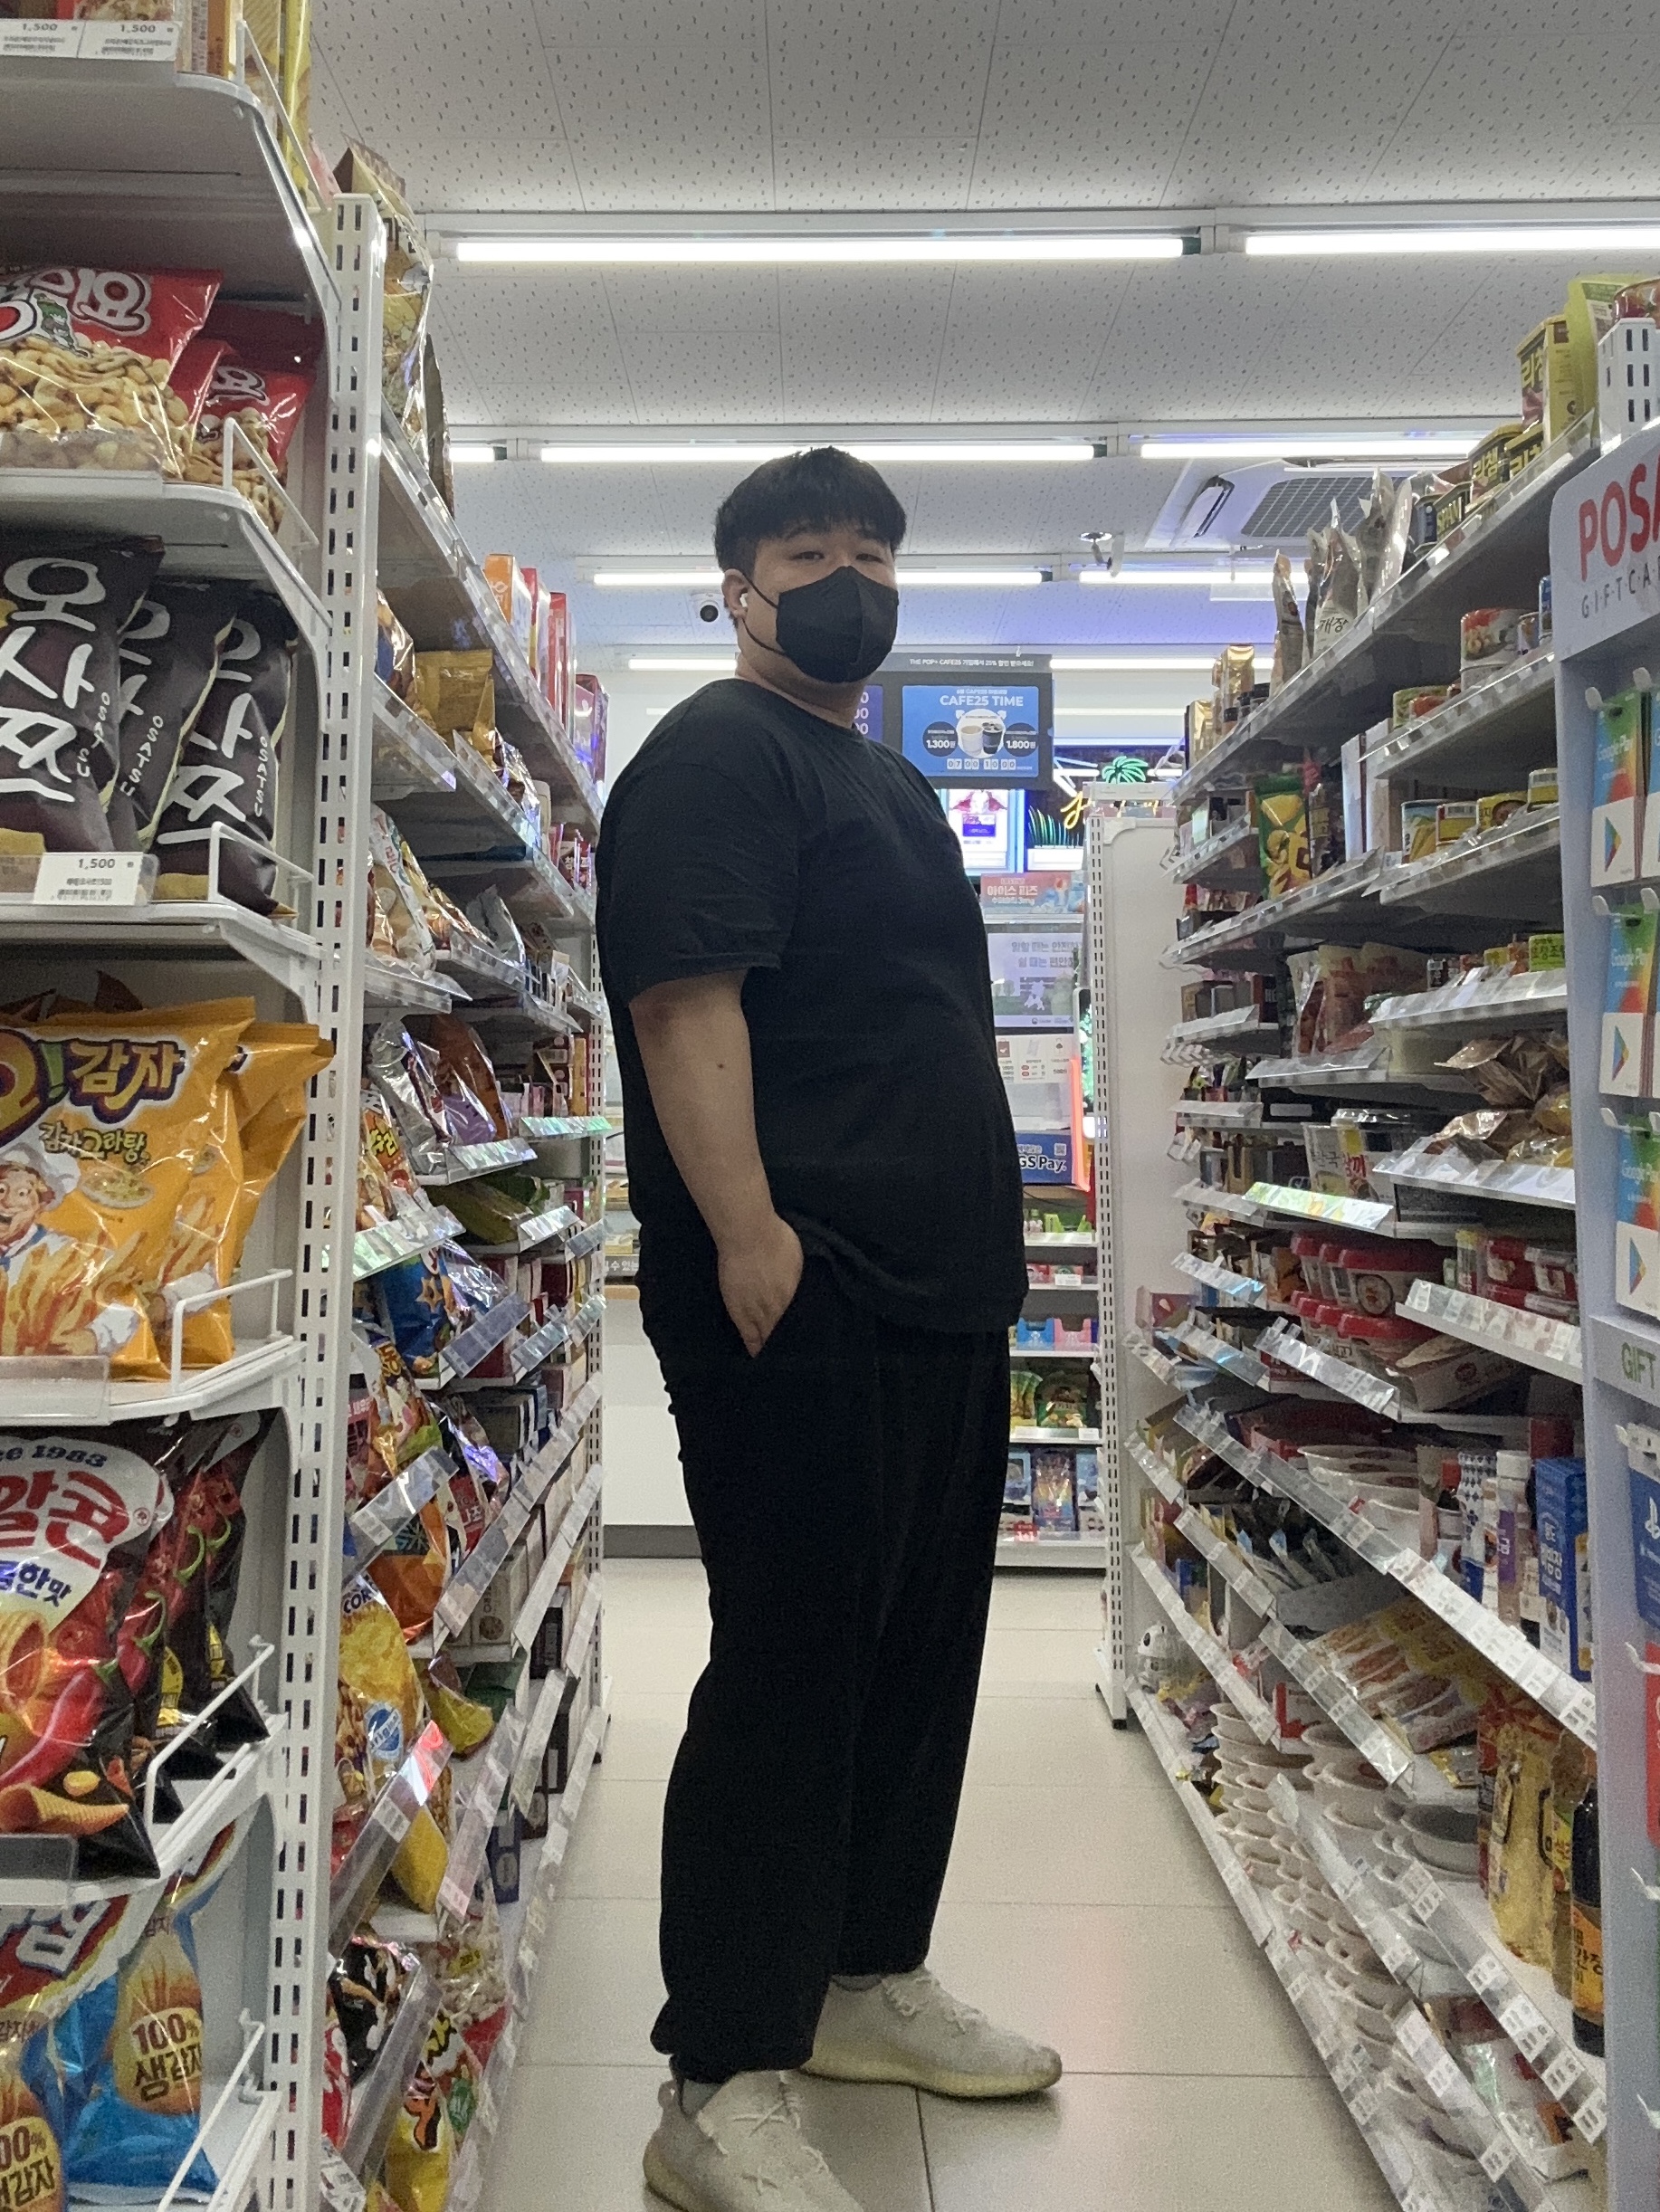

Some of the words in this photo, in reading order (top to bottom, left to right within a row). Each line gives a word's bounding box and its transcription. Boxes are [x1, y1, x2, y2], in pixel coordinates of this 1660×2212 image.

[940, 695, 988, 707] CAFE25
[991, 696, 1024, 707] TIME
[76, 691, 111, 778] OSATSU
[119, 715, 164, 796] OSATSU
[253, 736, 269, 816] OSATSU
[79, 858, 116, 870] 1,500
[987, 886, 1016, 896] 아이스
[1019, 1155, 1036, 1168] GS
[1621, 1342, 1656, 1390] GIFT
[33, 1444, 108, 1468] 1983
[133, 2013, 199, 2055] 100%
